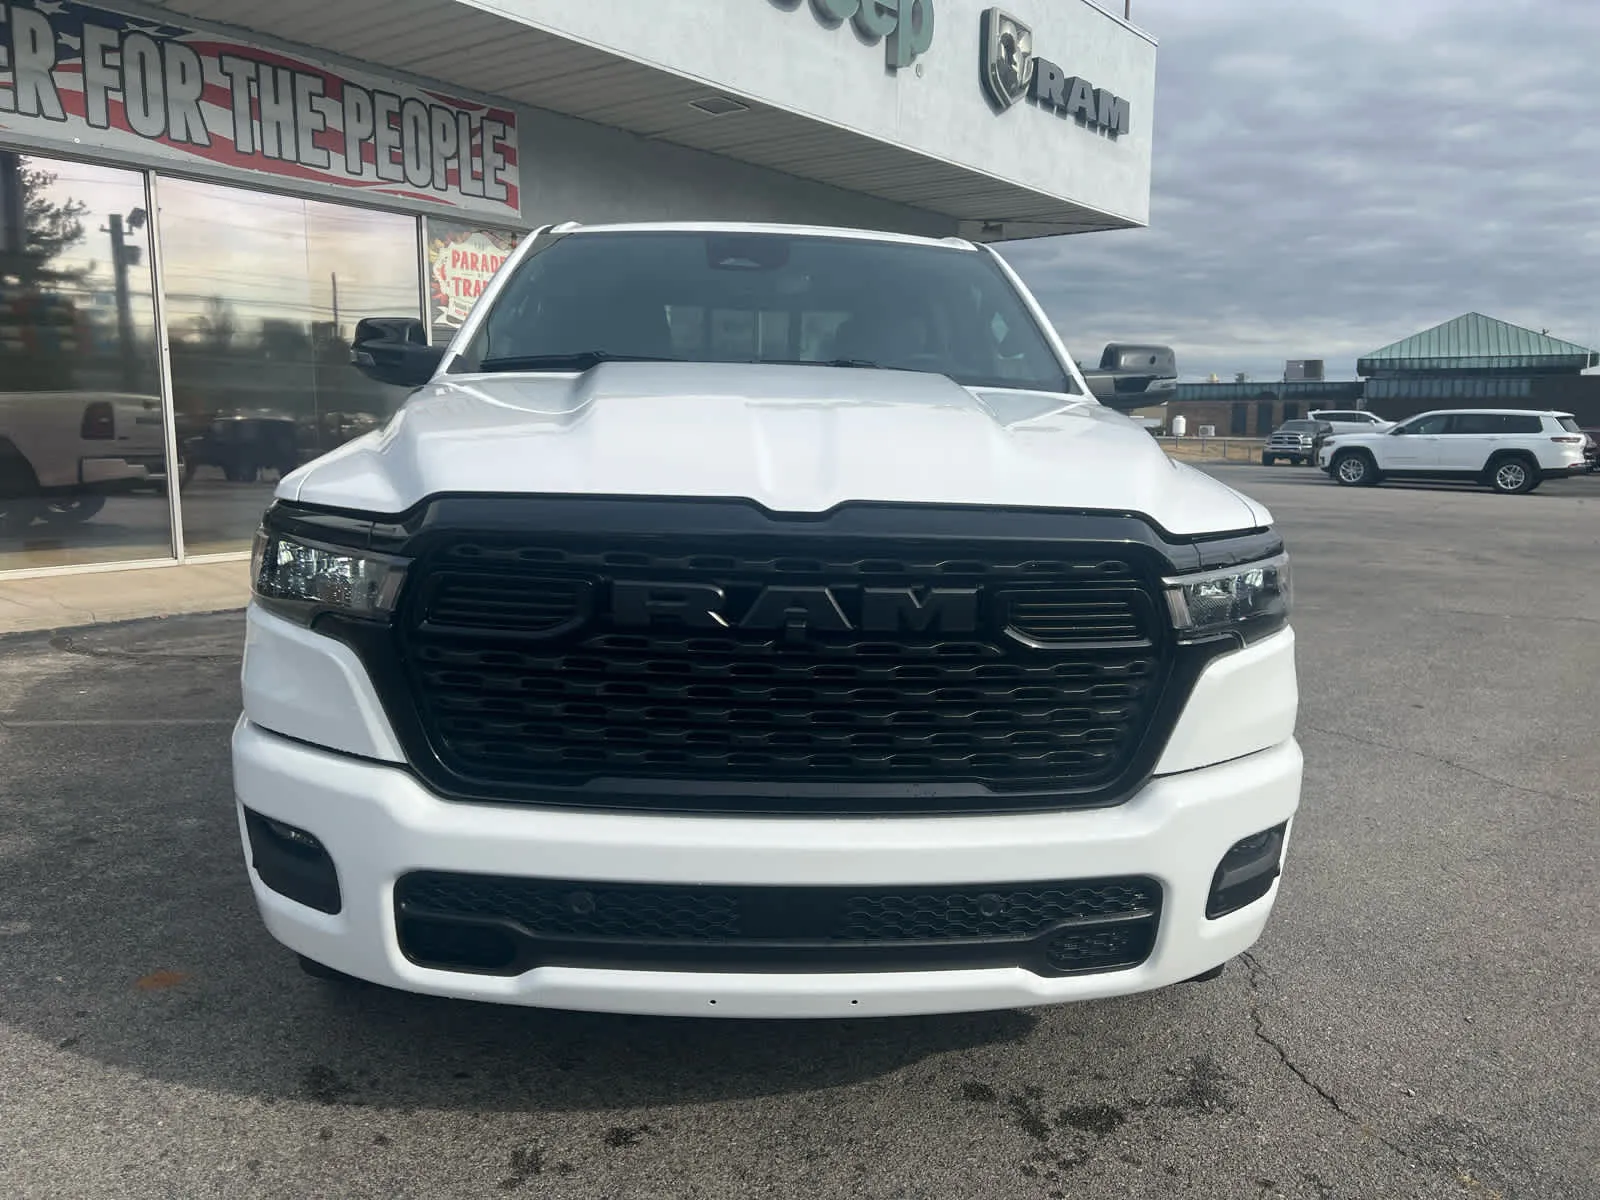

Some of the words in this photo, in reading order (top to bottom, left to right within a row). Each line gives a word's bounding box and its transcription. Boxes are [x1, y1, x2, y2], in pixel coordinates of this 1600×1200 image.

[82, 23, 211, 147] FOR
[218, 51, 330, 170] THE
[341, 83, 508, 202] PEOPLE
[1029, 57, 1130, 135] RAM
[611, 579, 979, 633] RAM
